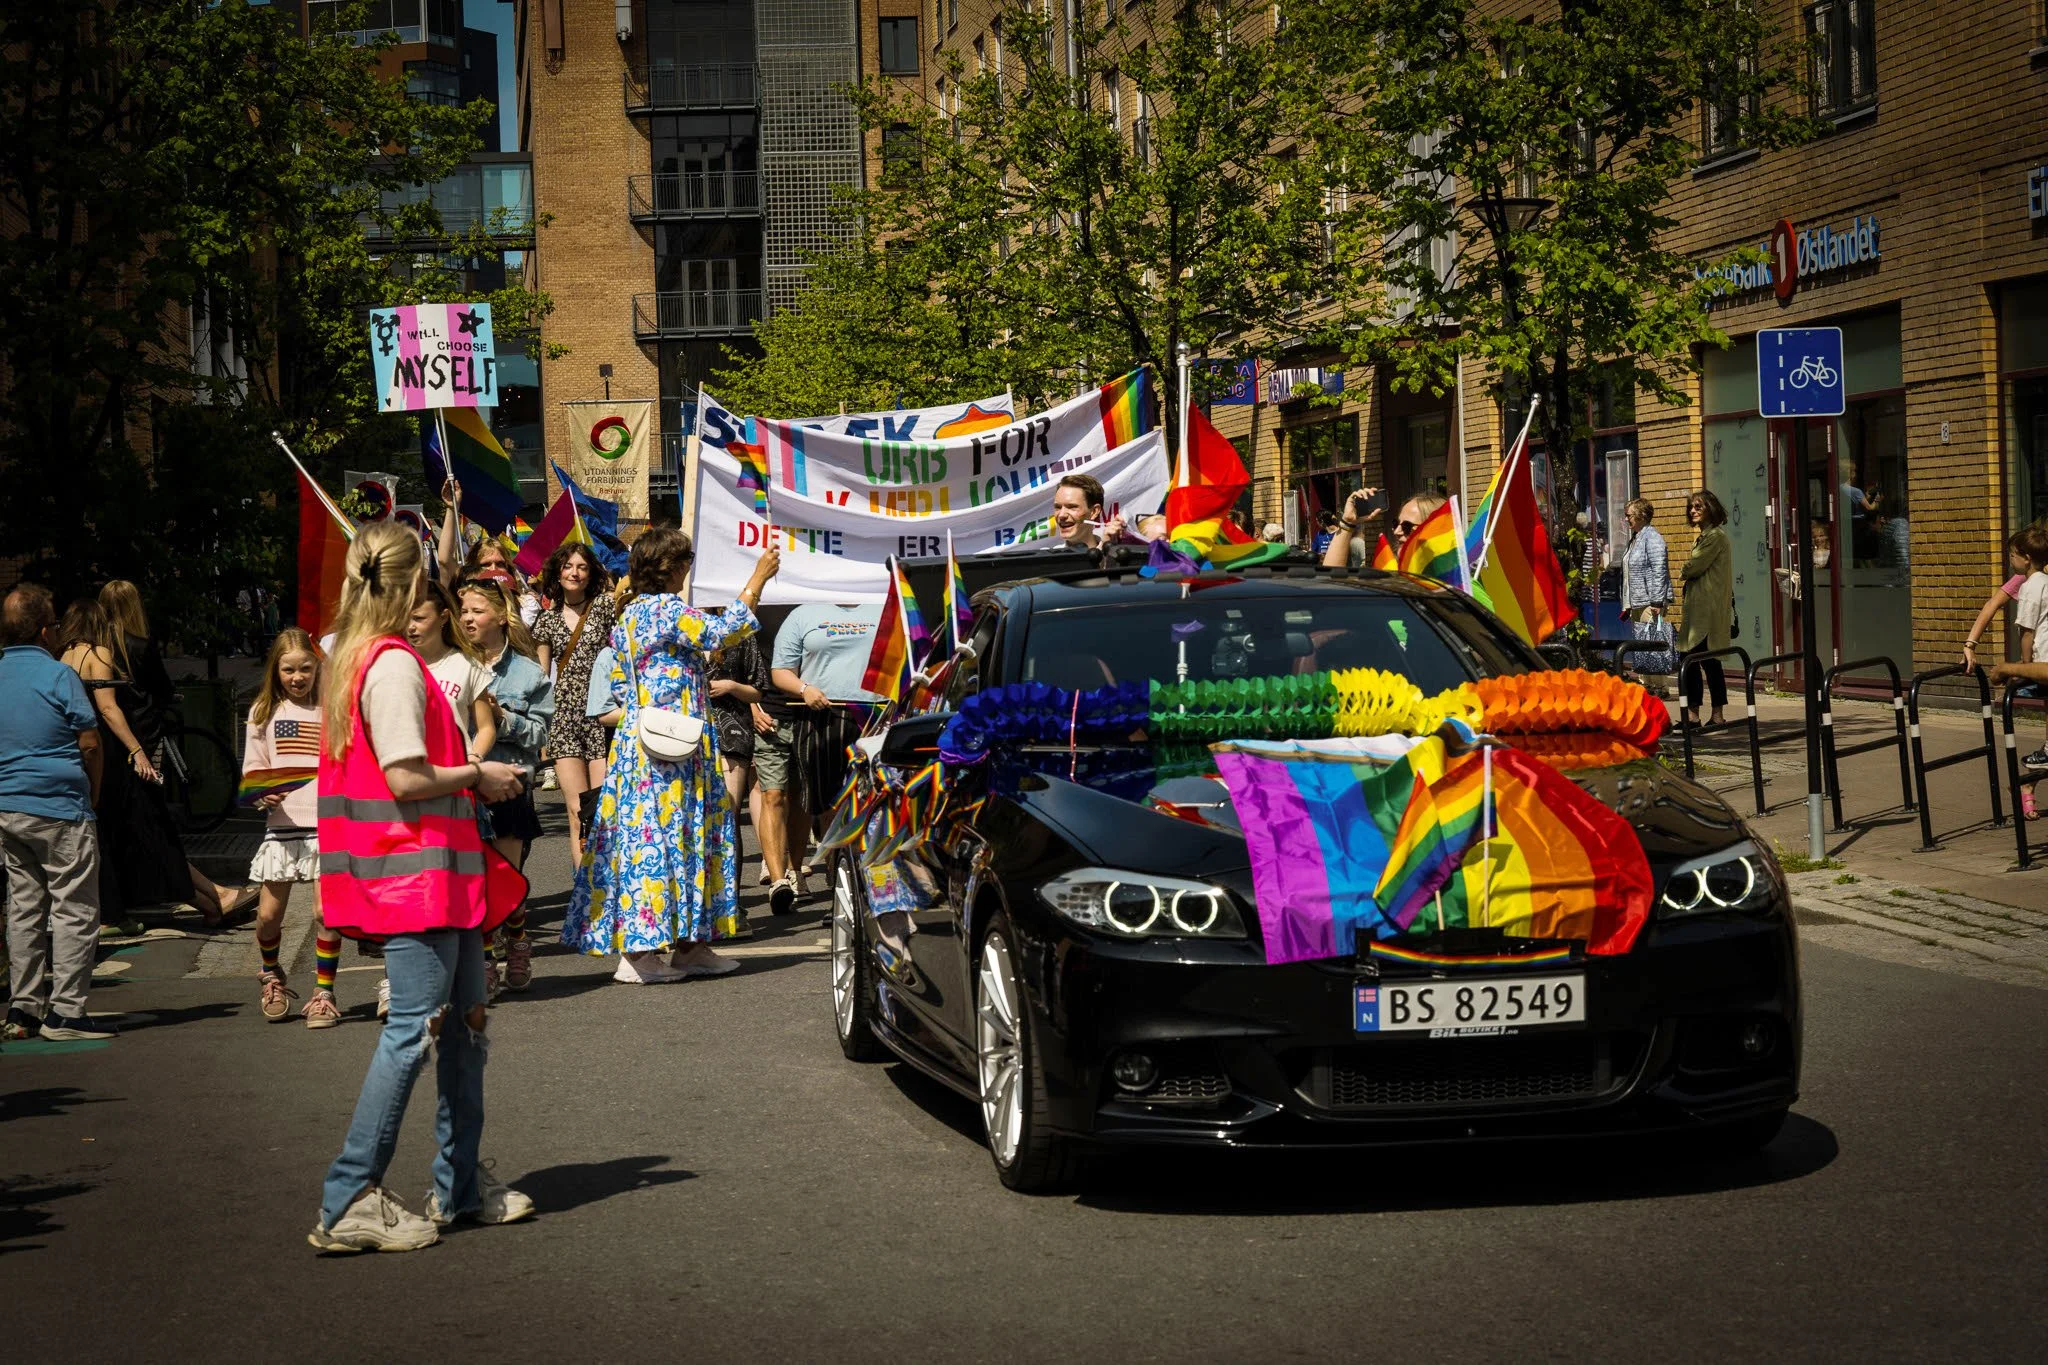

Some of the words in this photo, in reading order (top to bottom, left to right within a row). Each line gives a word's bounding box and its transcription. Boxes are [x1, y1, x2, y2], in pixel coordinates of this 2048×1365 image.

[1776, 234, 1787, 283] 1
[1797, 216, 1878, 278] Østlandet
[407, 328, 440, 340] WILL
[437, 341, 488, 353] CHOOSE
[394, 353, 496, 396] MYSELF
[970, 416, 1051, 476] FOR
[583, 467, 638, 476] UTDANNINGS
[586, 476, 635, 485] FORBUNDET
[738, 520, 843, 556] DETTE
[898, 535, 941, 558] ER
[995, 502, 1120, 547] BÆM
[1390, 988, 1436, 1024] BS
[1455, 982, 1573, 1022] 82549
[1362, 1013, 1373, 1024] N
